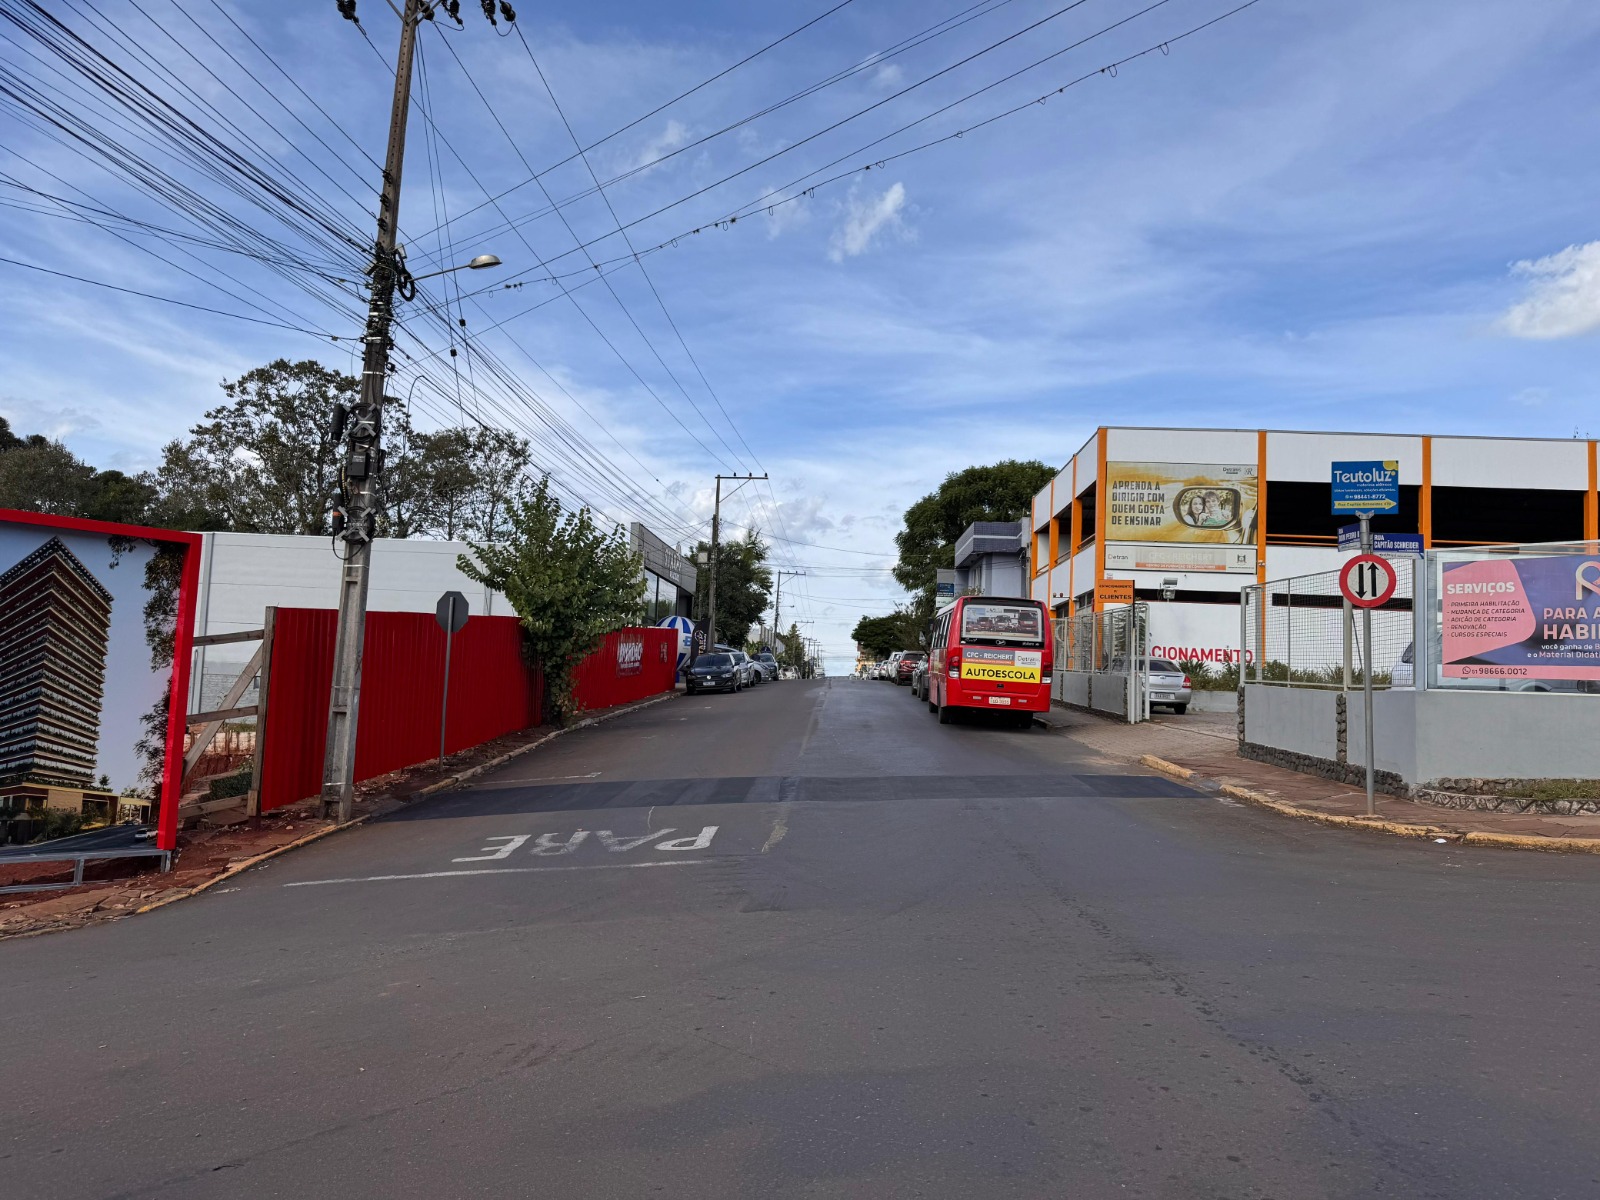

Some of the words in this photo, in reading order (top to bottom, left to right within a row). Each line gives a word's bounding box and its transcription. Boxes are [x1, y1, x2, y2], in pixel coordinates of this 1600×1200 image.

[1334, 468, 1392, 483] Teutoluz
[1112, 480, 1152, 491] APRENDA
[1154, 481, 1161, 491] A
[1112, 492, 1145, 502] DIRIGIR
[1147, 492, 1165, 503] COM
[1112, 504, 1136, 514] QUEM
[1138, 504, 1165, 515] GOSTA
[1112, 515, 1122, 525] DE
[1124, 516, 1161, 526] ENSINAR
[1374, 540, 1393, 549] CAPITÃO
[1394, 541, 1419, 549] SCHNEIDER
[1447, 581, 1515, 596] SERVIÇOS
[1544, 606, 1588, 620] PARA
[1543, 623, 1600, 640] HABI
[983, 652, 1013, 660] REICHERT
[966, 668, 1036, 680] AUTOESCOLA
[1479, 667, 1528, 675] 98666.0012
[451, 826, 719, 863] PARE
